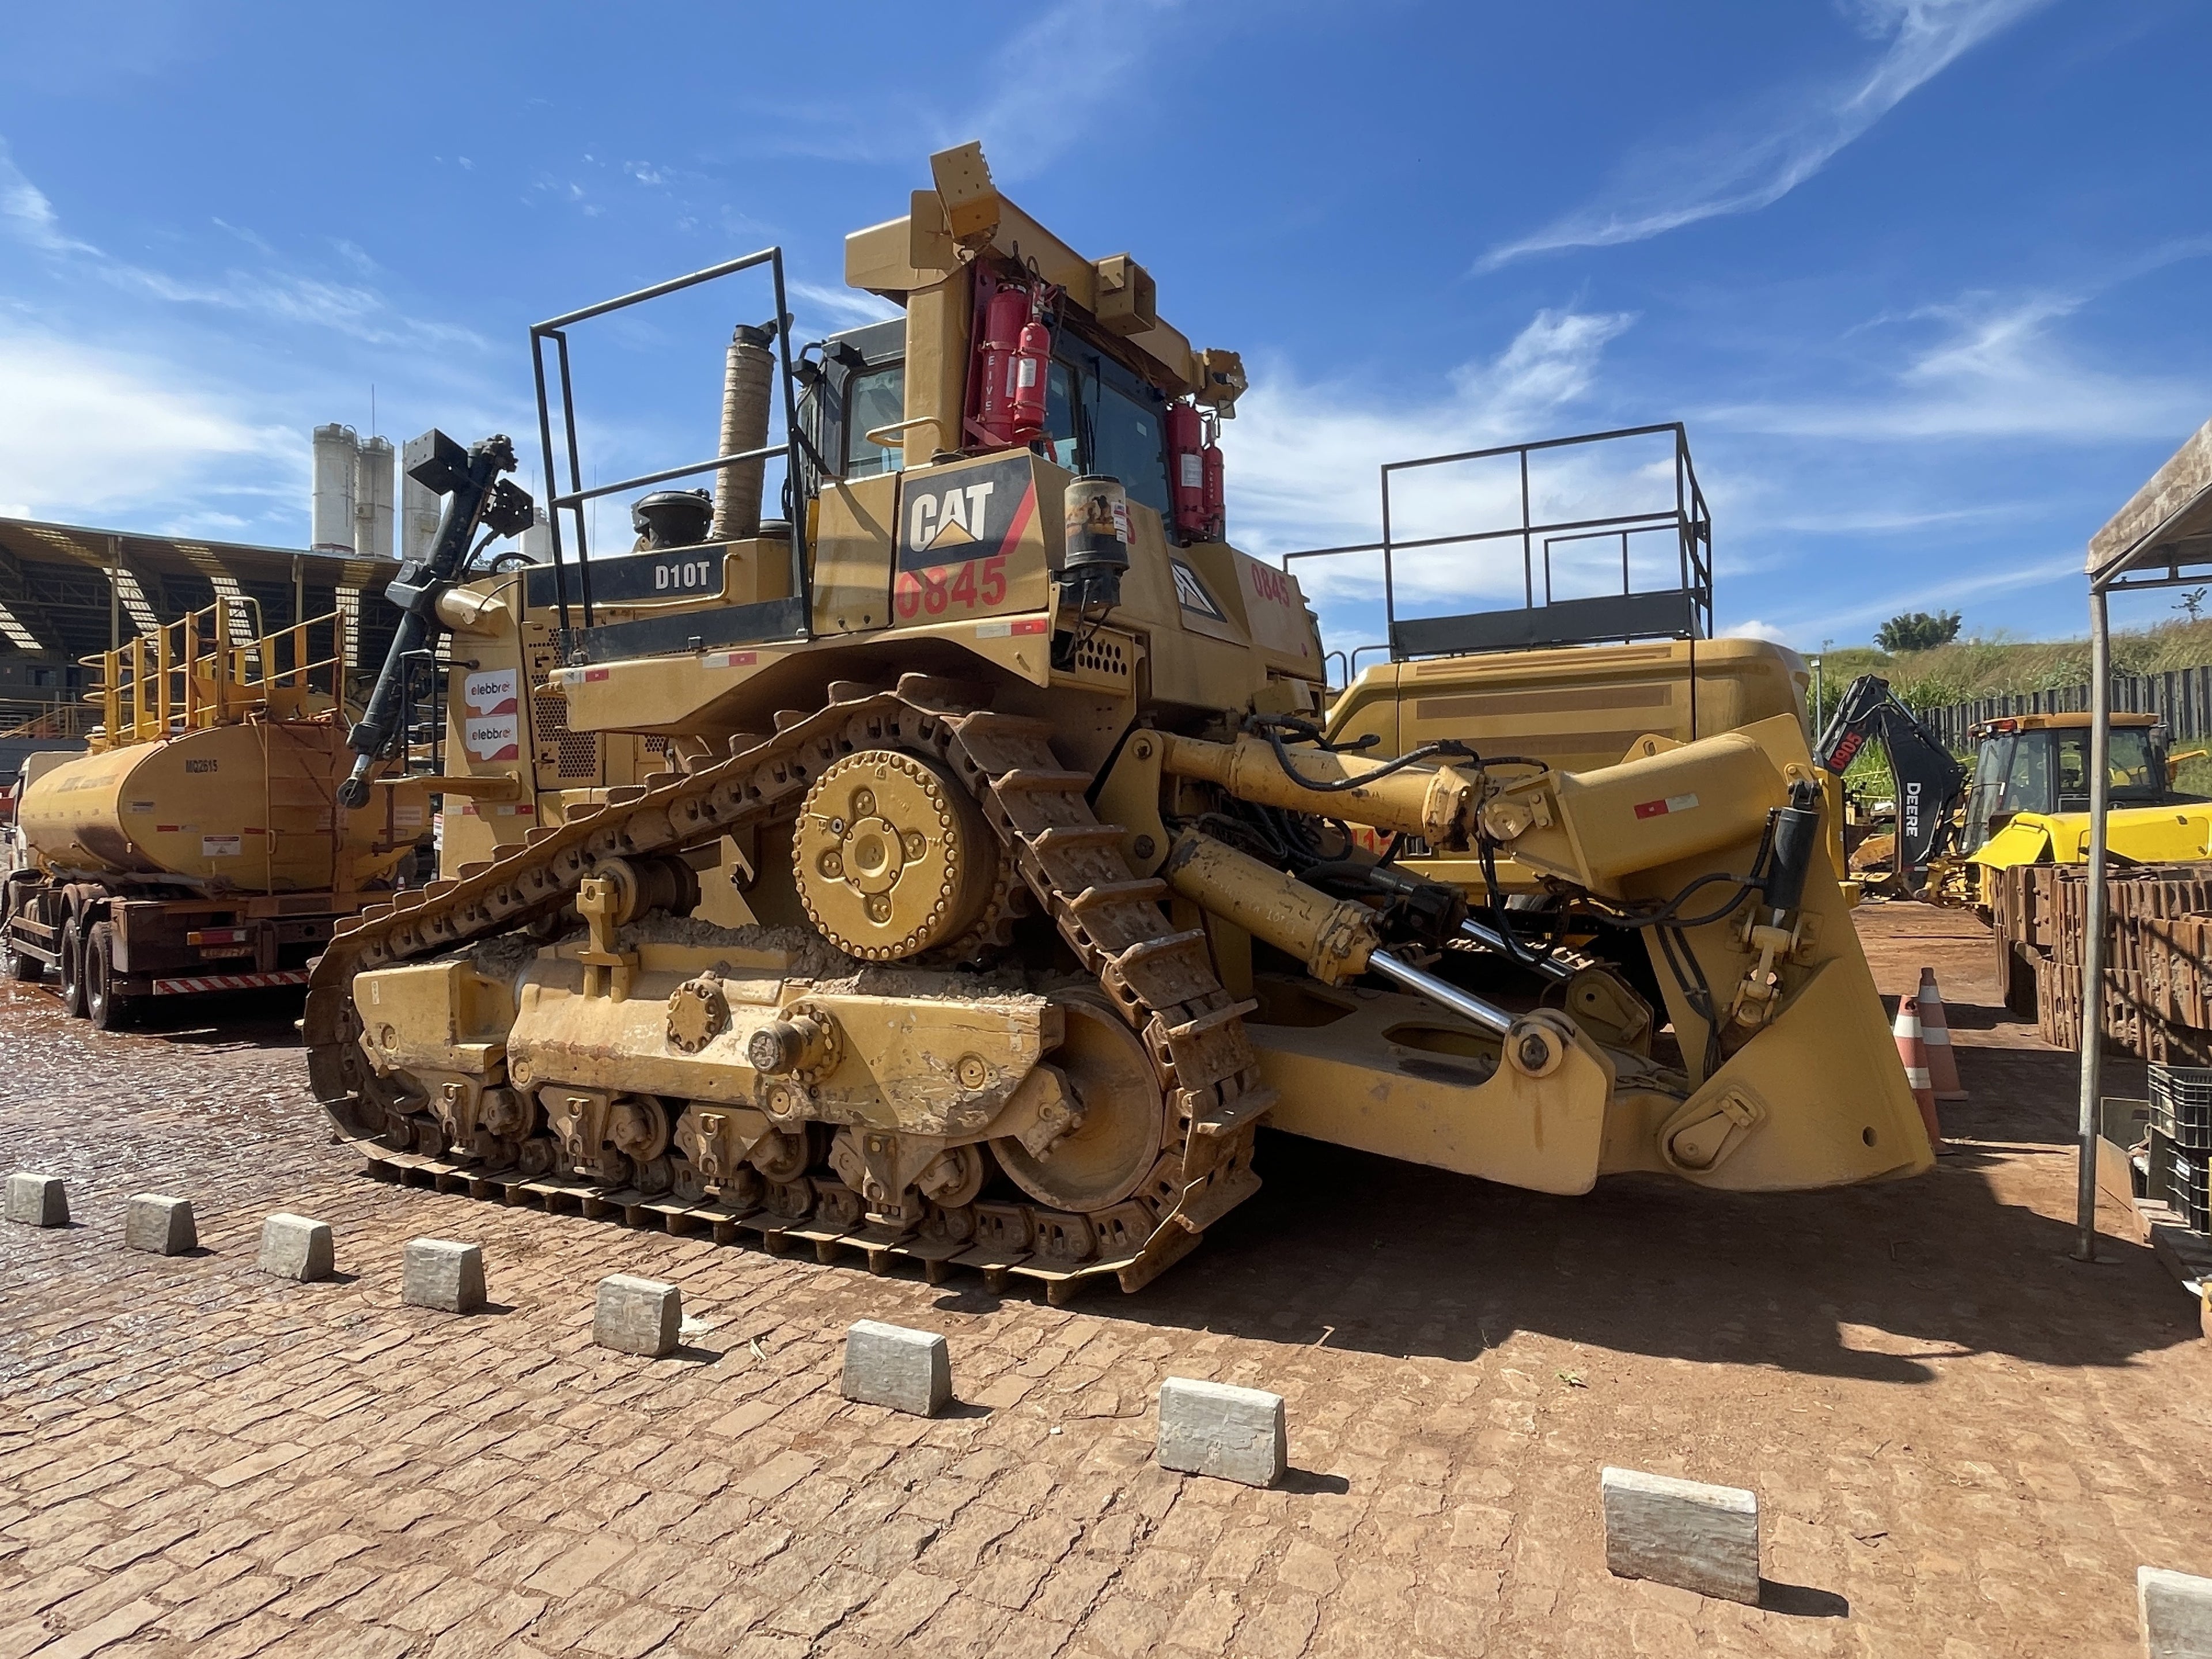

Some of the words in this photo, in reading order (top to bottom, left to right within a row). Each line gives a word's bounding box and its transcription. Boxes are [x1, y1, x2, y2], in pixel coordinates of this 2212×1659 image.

[910, 482, 994, 552] CAT
[655, 561, 710, 589] D10T
[895, 556, 1007, 619] 0845
[1251, 563, 1290, 608] 0845
[1830, 731, 1863, 770] 0905
[1906, 782, 1922, 838] DEERE
